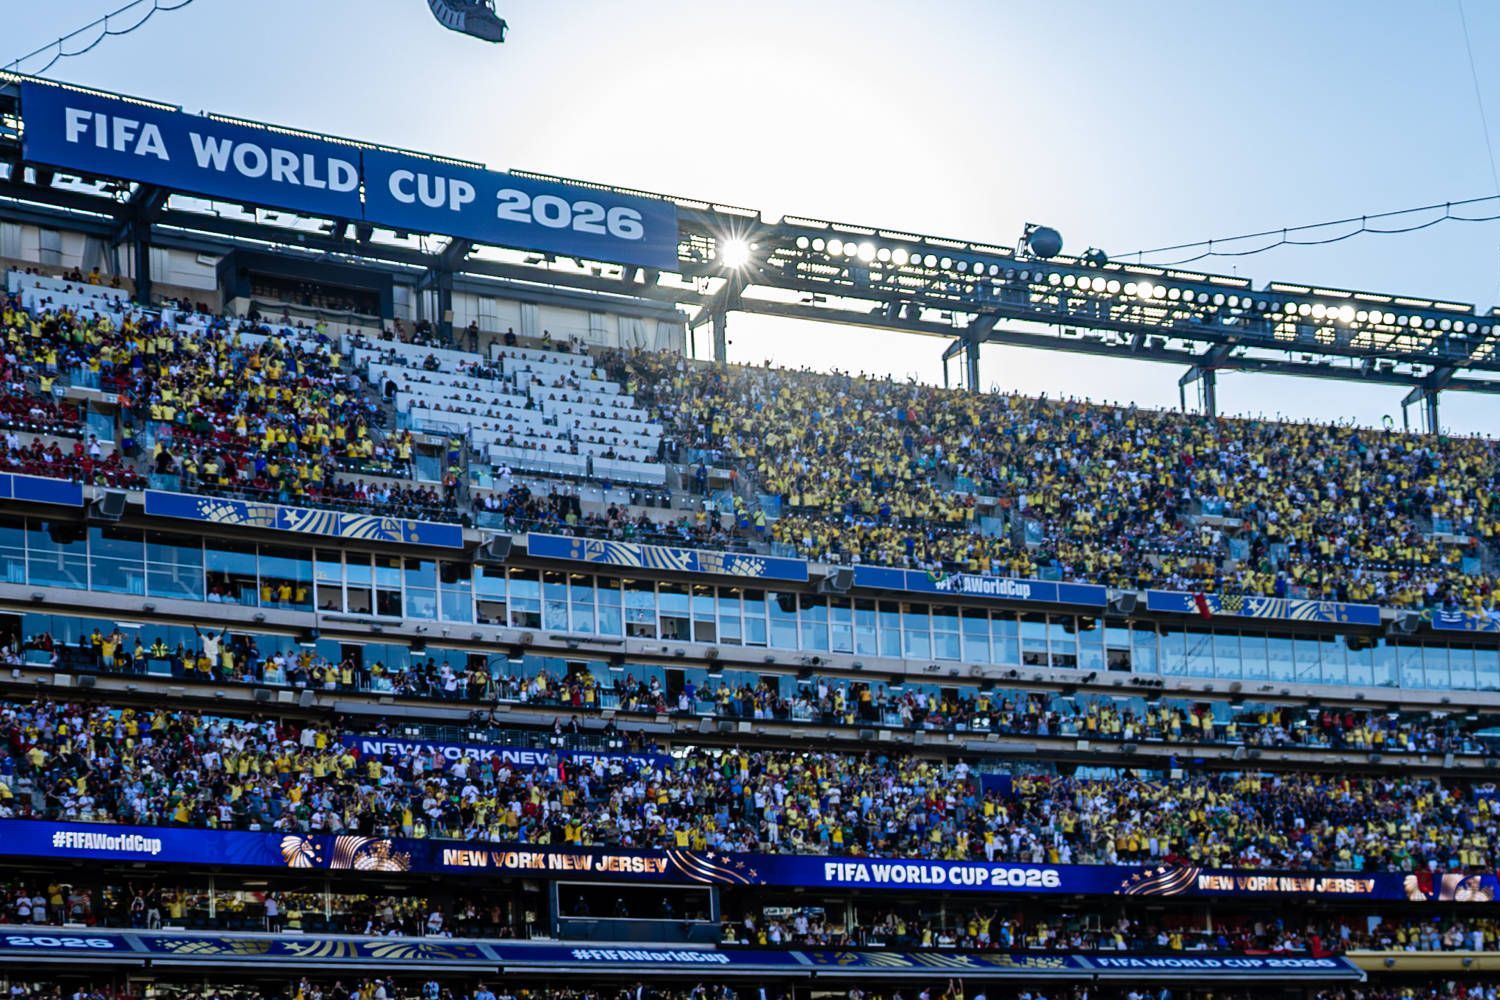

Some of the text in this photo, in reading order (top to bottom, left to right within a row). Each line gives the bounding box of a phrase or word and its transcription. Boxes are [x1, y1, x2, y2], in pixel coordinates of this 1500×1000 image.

[65, 107, 644, 240] FIFA WORLD CUP 2026
[53, 831, 161, 855] #FIFAWorldCup
[443, 849, 668, 873] NEW YORK NEW JERSEY
[824, 862, 1059, 887] FIFA WORLD CUP 2026
[1199, 875, 1375, 893] NEW YORK NEW JERSEY
[6, 936, 114, 948] 2026
[571, 949, 730, 964] #FIFAWorldCup
[1097, 958, 1337, 968] FIFA WORLD CUP 2026
